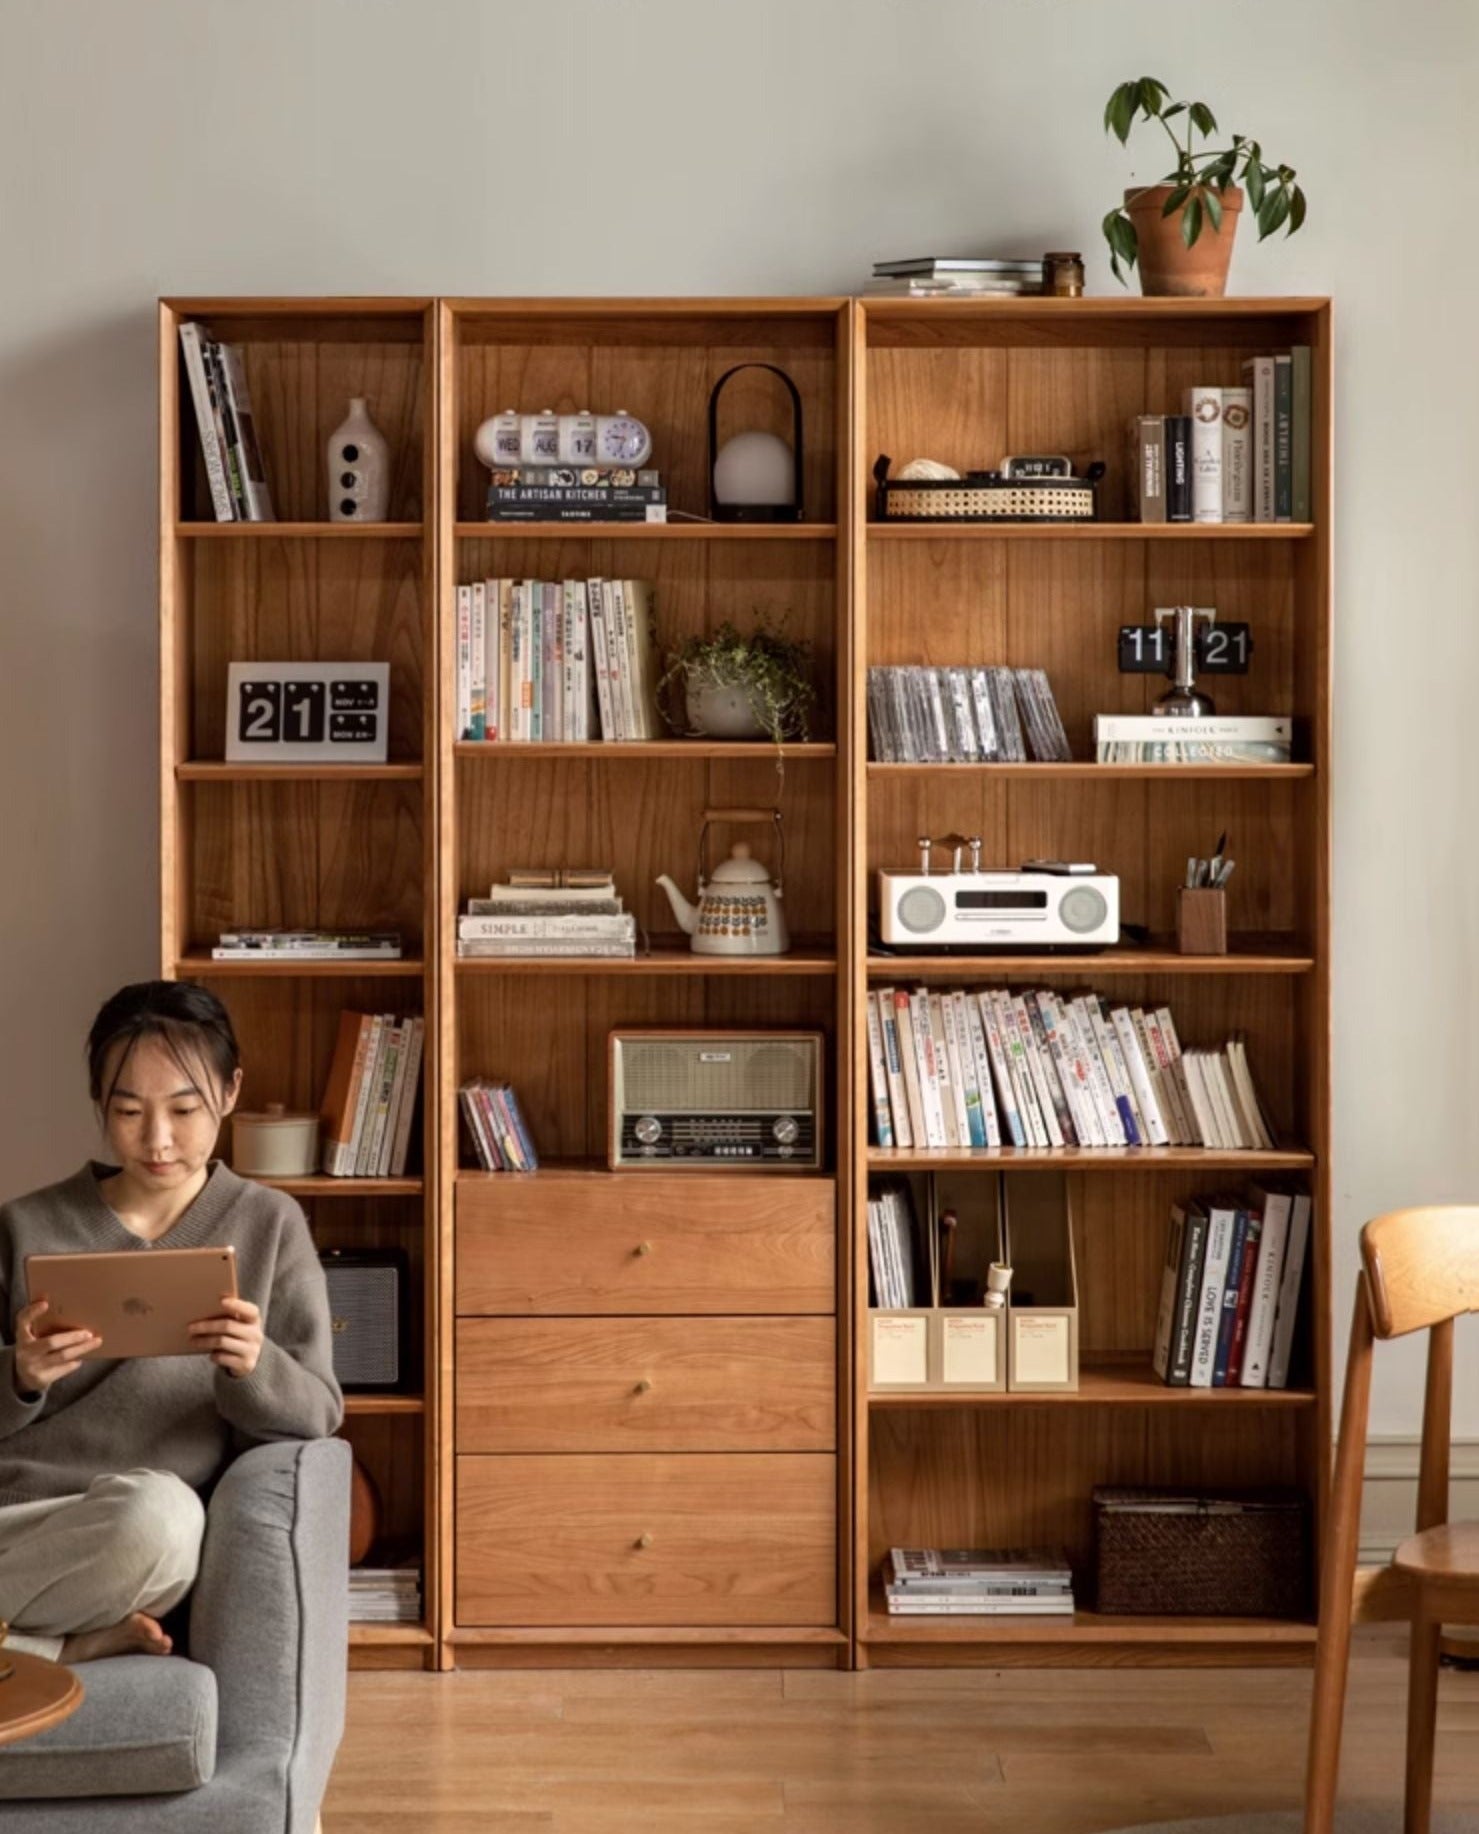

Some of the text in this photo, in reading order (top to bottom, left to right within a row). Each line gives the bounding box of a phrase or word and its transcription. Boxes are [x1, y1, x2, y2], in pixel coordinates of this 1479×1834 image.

[576, 439, 593, 453] 17
[1175, 441, 1185, 485] LIGHTING
[499, 489, 516, 500] THE
[520, 489, 562, 500] ARTISAN
[565, 489, 607, 500] KITCHEN
[1130, 627, 1162, 662] 11
[1206, 631, 1246, 664] 21
[246, 698, 311, 737] 21
[481, 923, 528, 934] SIMPLE
[1203, 1286, 1217, 1312] LOVE
[1197, 1328, 1211, 1364] SERVED
